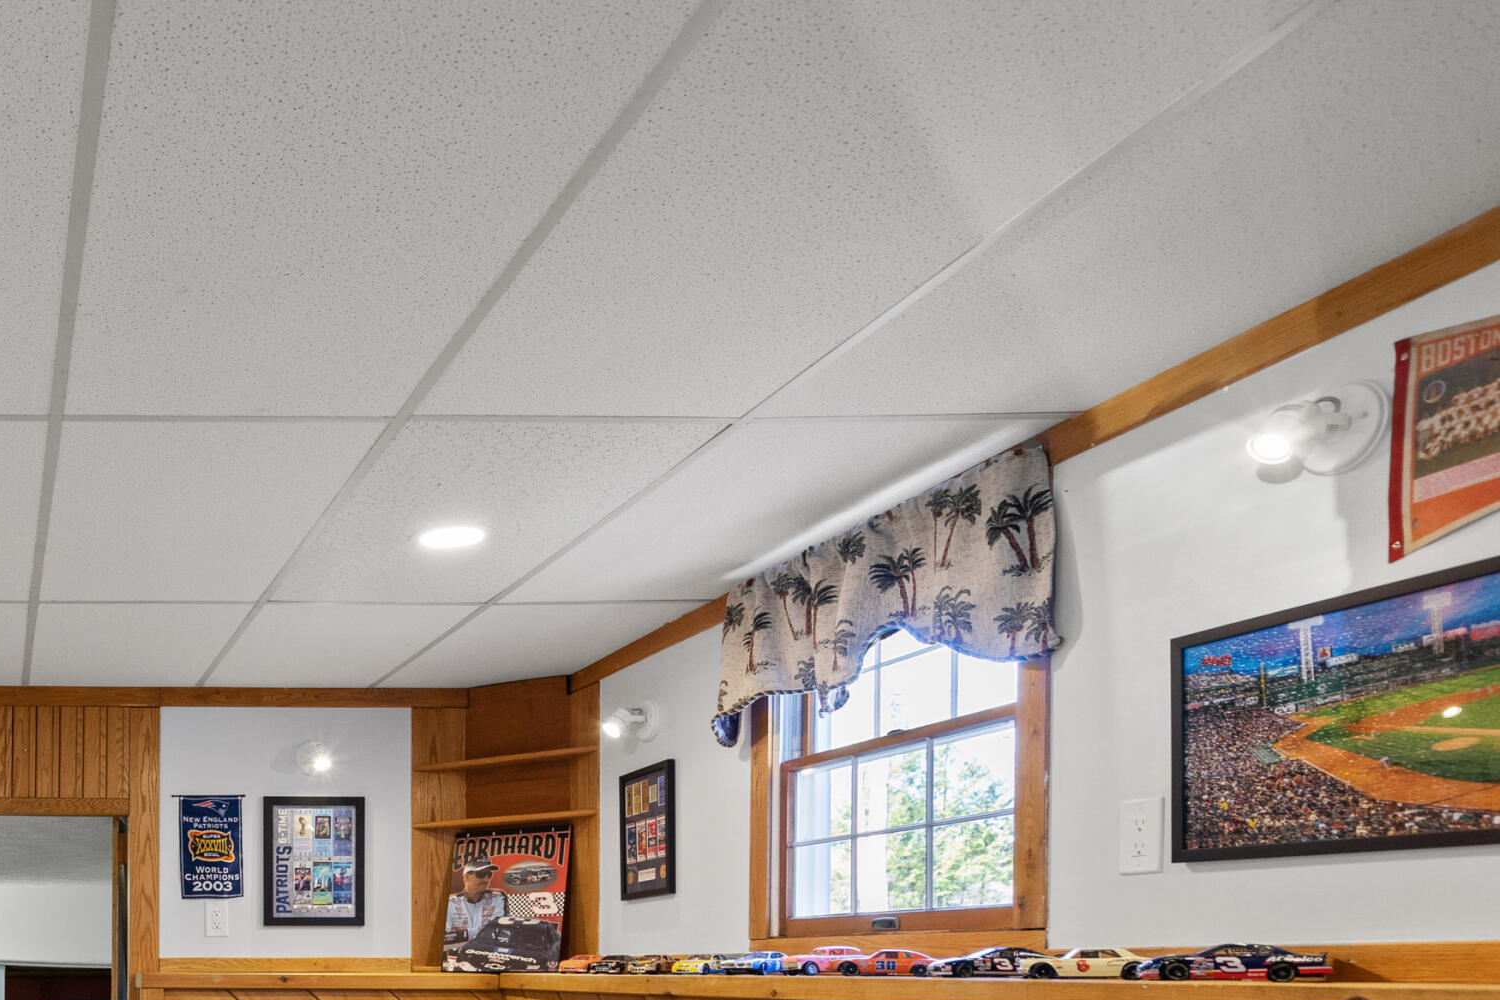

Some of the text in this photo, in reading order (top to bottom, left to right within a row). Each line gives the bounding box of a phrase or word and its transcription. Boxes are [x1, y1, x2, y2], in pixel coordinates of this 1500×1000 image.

[452, 831, 570, 871] EARNHARDT
[195, 866, 229, 874] WORLD
[185, 873, 240, 881] CHAMPIONS
[276, 846, 292, 914] PATRIOTS
[192, 881, 233, 892] 2003
[530, 892, 559, 915] 3
[875, 960, 896, 971] 30
[993, 958, 1014, 971] 3
[1076, 959, 1090, 972] 8
[1215, 956, 1247, 973] 3
